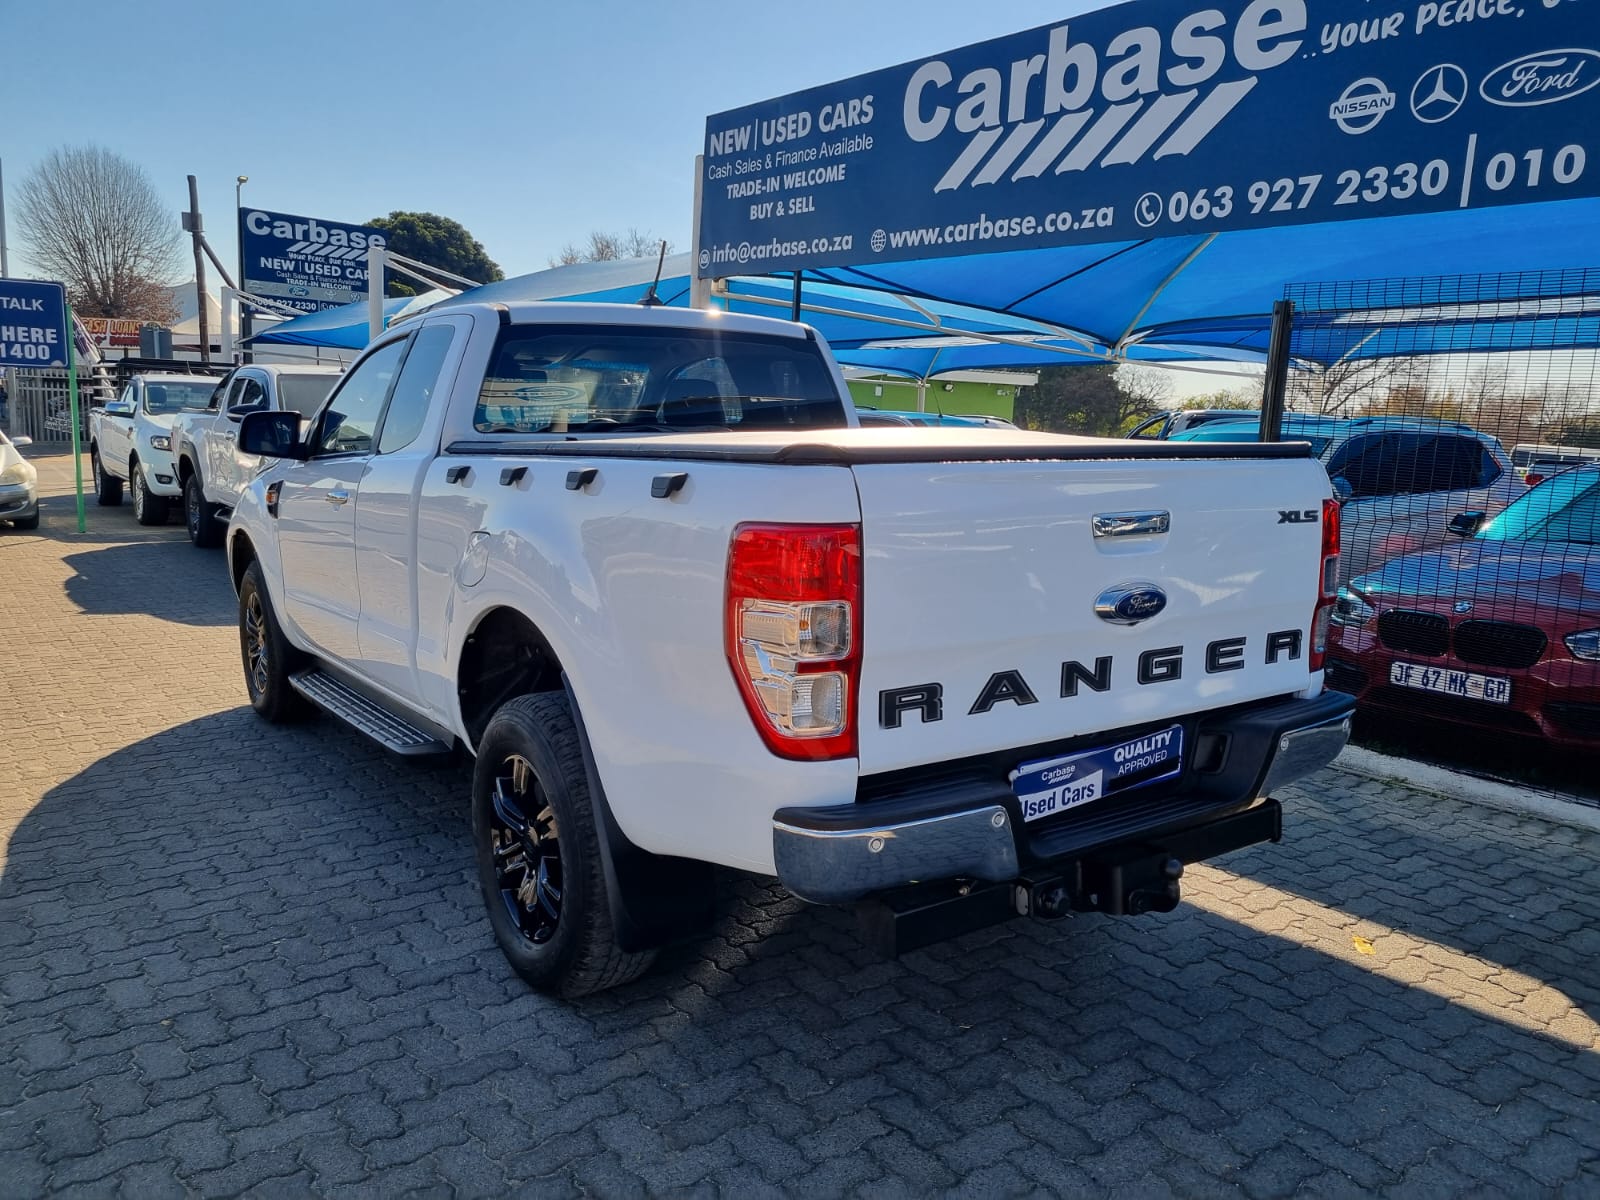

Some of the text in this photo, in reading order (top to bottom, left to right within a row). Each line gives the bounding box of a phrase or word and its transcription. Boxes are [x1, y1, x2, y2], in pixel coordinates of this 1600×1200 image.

[903, 0, 1308, 143] Carbase
[1501, 57, 1586, 98] Ford
[1333, 97, 1391, 116] NISSAN
[709, 94, 874, 157] NEW USED CARS
[708, 133, 873, 180] Cash Sales & Finance Available
[1485, 144, 1586, 191] 010
[727, 163, 846, 200] TRADE-IN WELCOME
[1168, 159, 1449, 223] 063 927 2330
[749, 195, 815, 221] BUY & SELL
[246, 211, 387, 250] Carbase
[889, 205, 1114, 249] www.carbase.co.za
[712, 233, 853, 265] info@carbase.co.za
[260, 256, 369, 280] NEW USED CAR
[320, 282, 352, 291] WELCOME
[0, 297, 44, 311] TALK
[295, 301, 317, 311] 2330
[1, 326, 58, 344] HERE
[879, 628, 1303, 730] RANGER
[1114, 731, 1173, 763] QUALITY
[1118, 750, 1167, 776] APPROVED
[1042, 764, 1076, 781] Carbase
[1022, 783, 1095, 818] Used Cars
